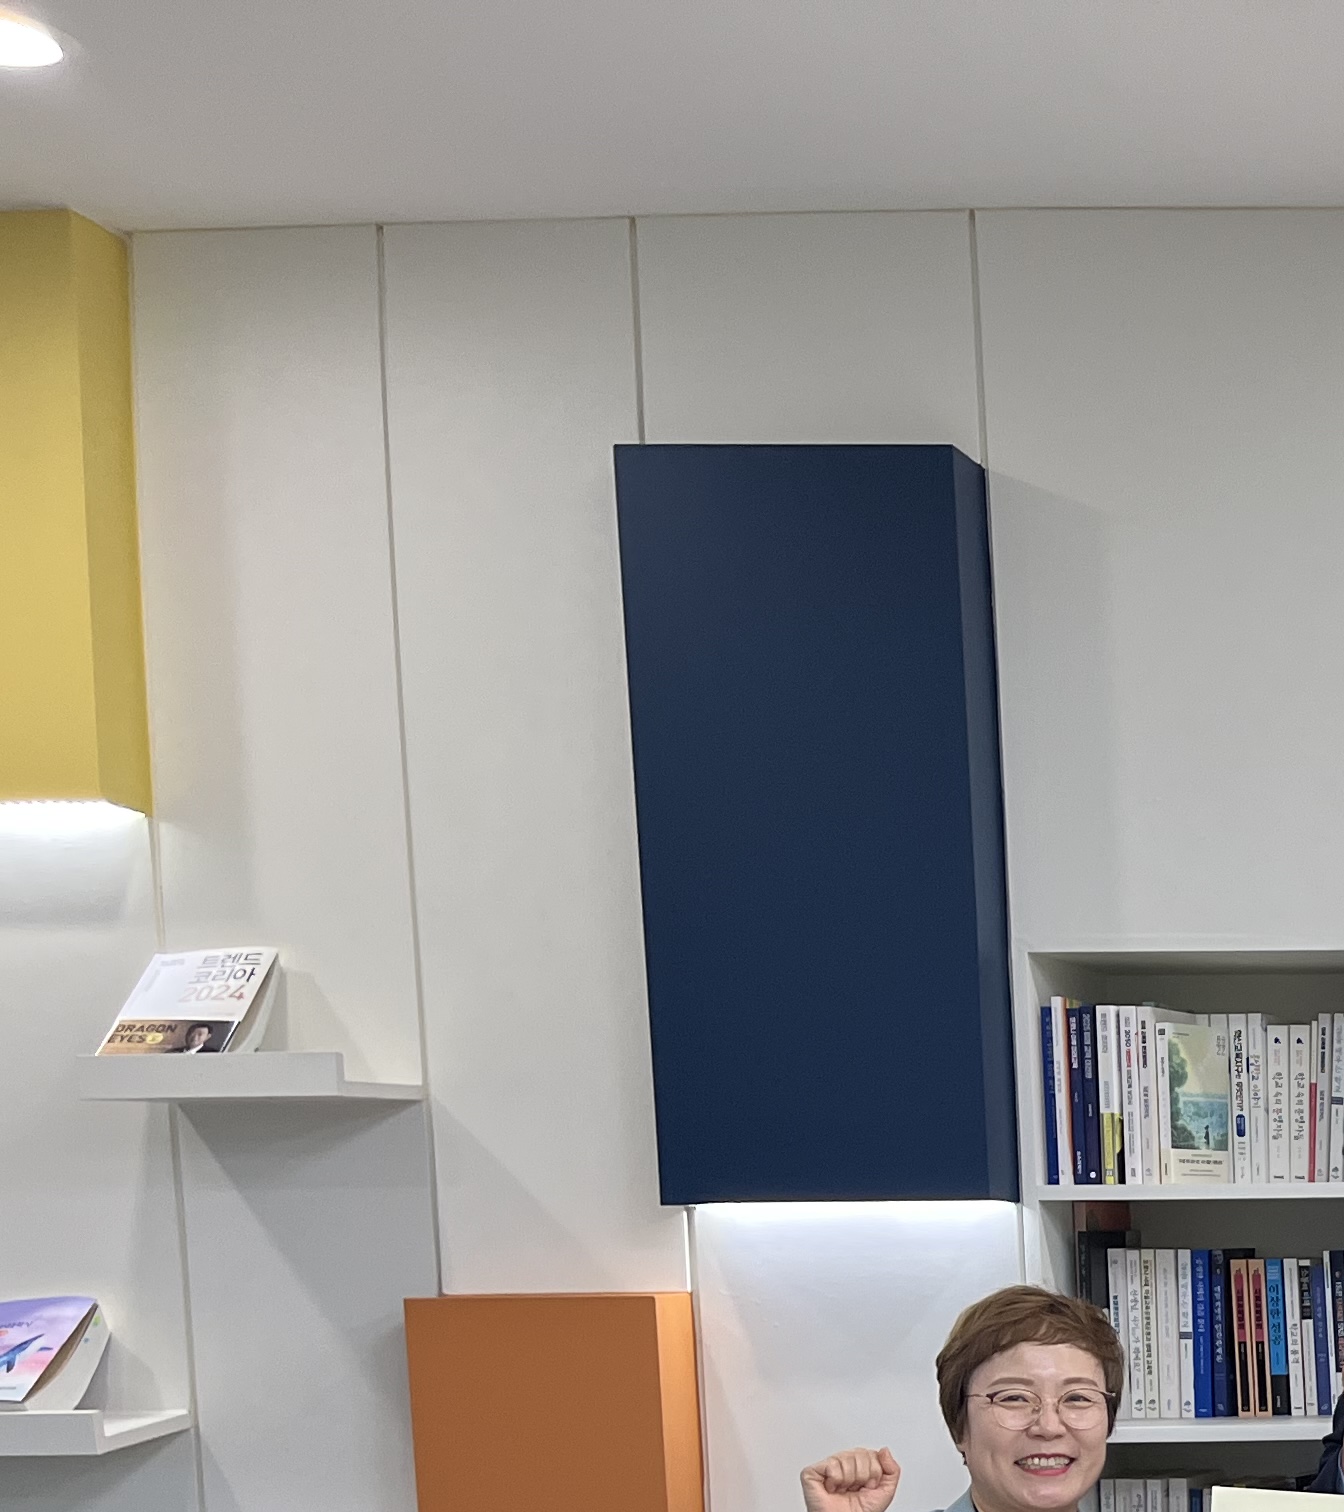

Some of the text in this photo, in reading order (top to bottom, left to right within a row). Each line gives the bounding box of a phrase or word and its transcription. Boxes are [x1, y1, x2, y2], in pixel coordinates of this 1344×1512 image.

[197, 952, 263, 968] 트렌드
[188, 967, 256, 984] 코리아
[178, 985, 247, 1003] 2024
[114, 1023, 178, 1034] DRAGON
[107, 1034, 147, 1044] EYES
[1271, 1071, 1284, 1089] 학교
[1294, 1072, 1306, 1089] 학교
[1268, 1283, 1283, 1346] 이상한 성공
[1289, 1323, 1299, 1346] 학교의
